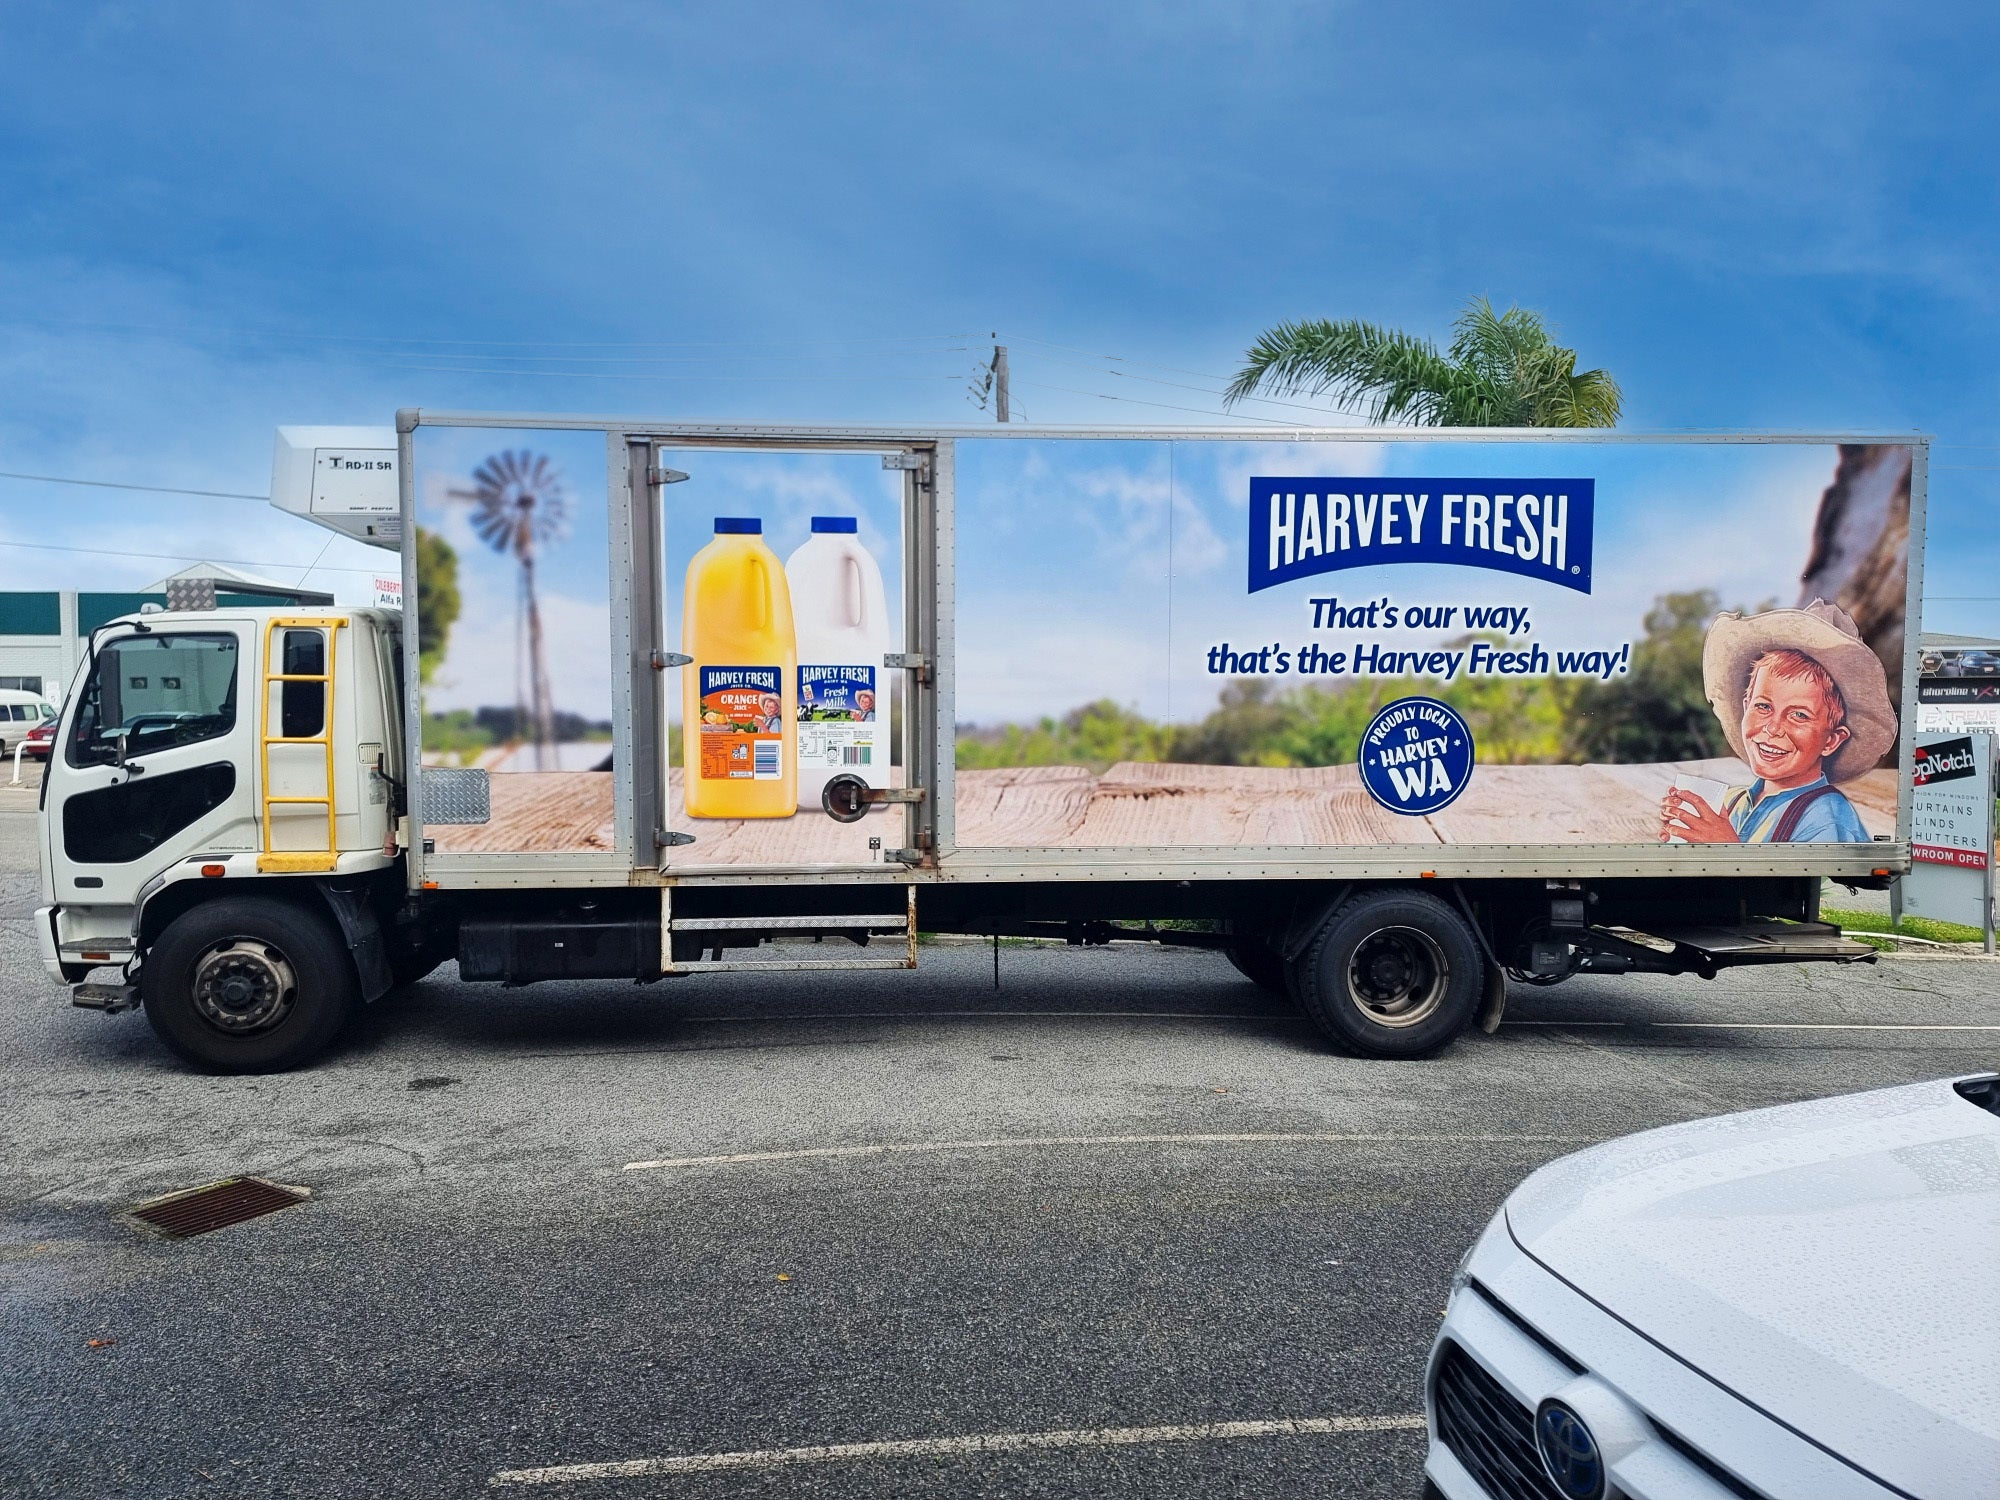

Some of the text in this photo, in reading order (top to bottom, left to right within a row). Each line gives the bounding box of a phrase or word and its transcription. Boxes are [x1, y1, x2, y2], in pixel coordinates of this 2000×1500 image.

[376, 461, 392, 471] SR
[1269, 493, 1568, 570] HARVEY FRESH
[380, 593, 394, 605] Alfa
[1309, 597, 1531, 635] That's our way,
[1207, 643, 1630, 680] that's the Harvey Fresh way!
[708, 671, 774, 689] HARVEY FRESH
[802, 666, 869, 685] HARVEY FRESH
[720, 694, 758, 705] ORANGE
[823, 685, 848, 698] Fresh
[825, 696, 846, 708] Milk
[1369, 706, 1451, 746] PROUDLY LOCAL
[1404, 726, 1419, 741] TO
[1380, 735, 1448, 768] HARVEY
[1387, 757, 1453, 802] WA
[1916, 802, 1973, 816] URTAINS
[1915, 817, 1954, 829] LINDS
[1915, 831, 1977, 848] HUTTERS
[1958, 853, 1986, 866] OPEN
